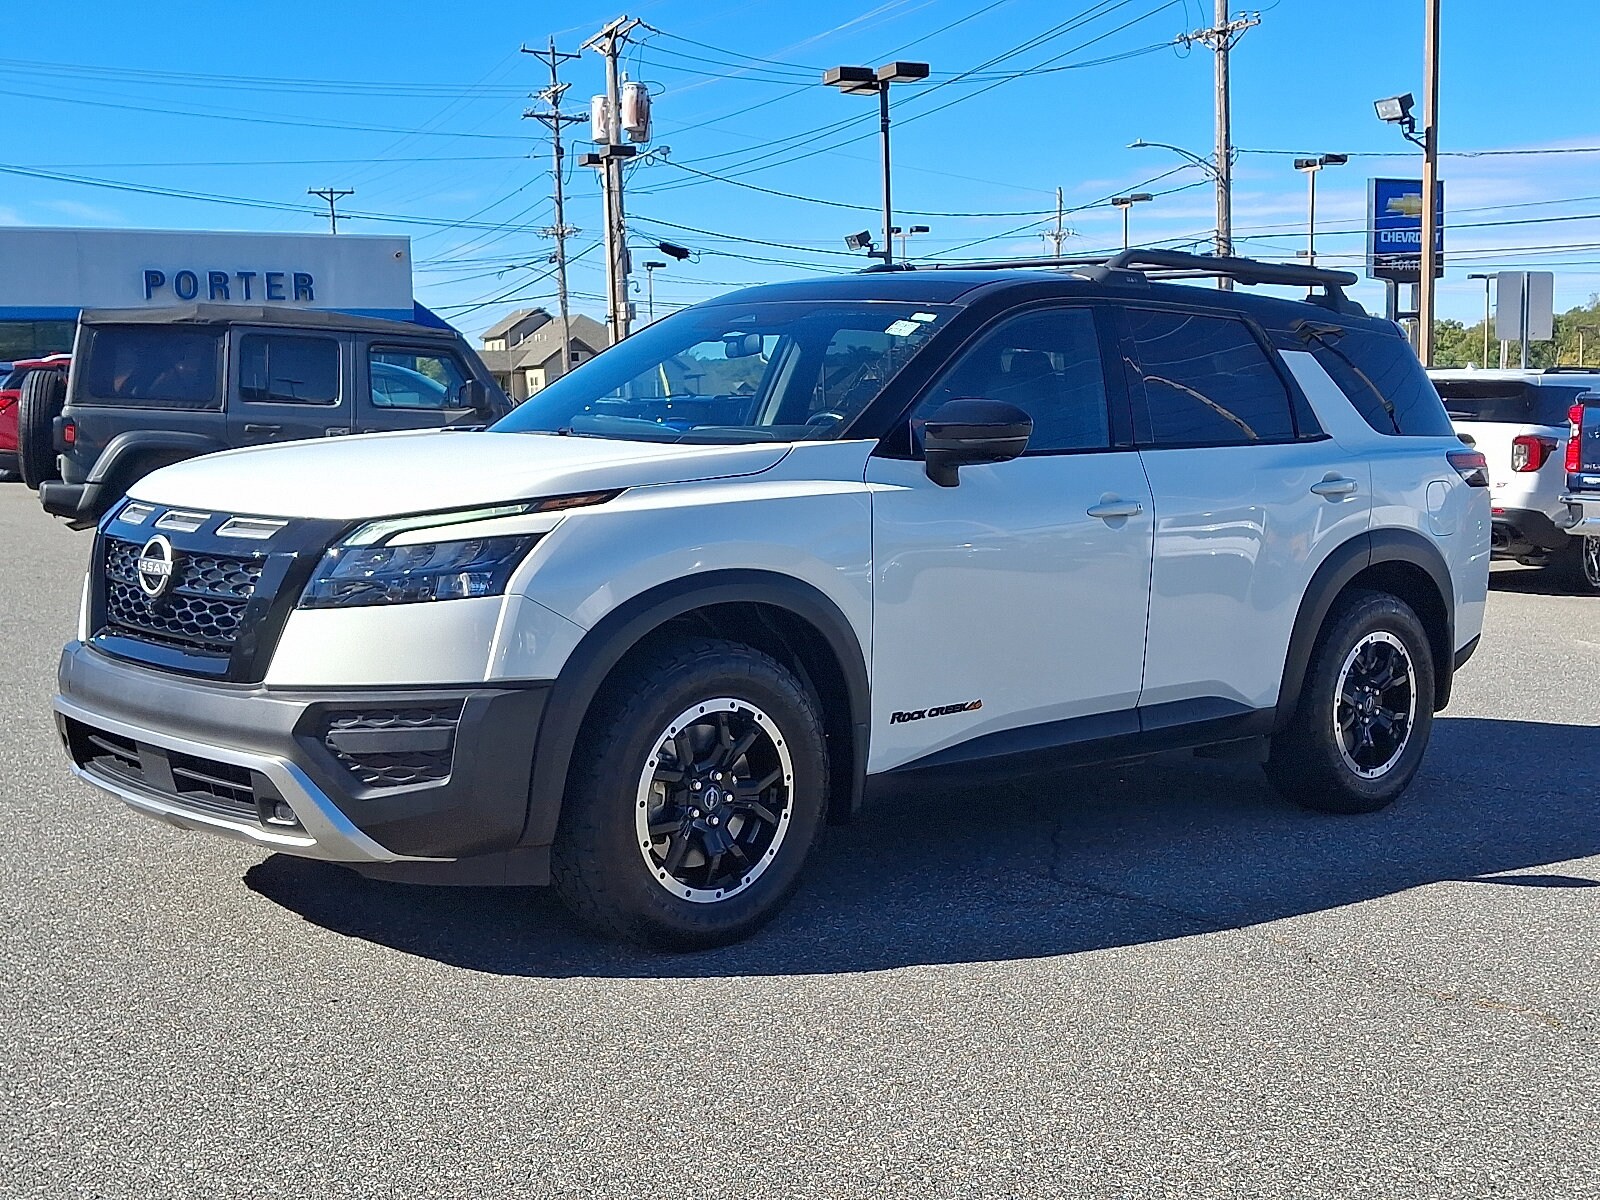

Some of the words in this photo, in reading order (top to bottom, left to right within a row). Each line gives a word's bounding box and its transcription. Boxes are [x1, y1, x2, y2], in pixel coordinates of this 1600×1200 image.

[1380, 231, 1440, 244] CHEVROT
[1391, 259, 1421, 271] PORTE
[142, 269, 315, 301] PORTER
[138, 558, 173, 576] ISSAN
[890, 710, 928, 725] ROCK
[928, 702, 969, 718] CREEK
